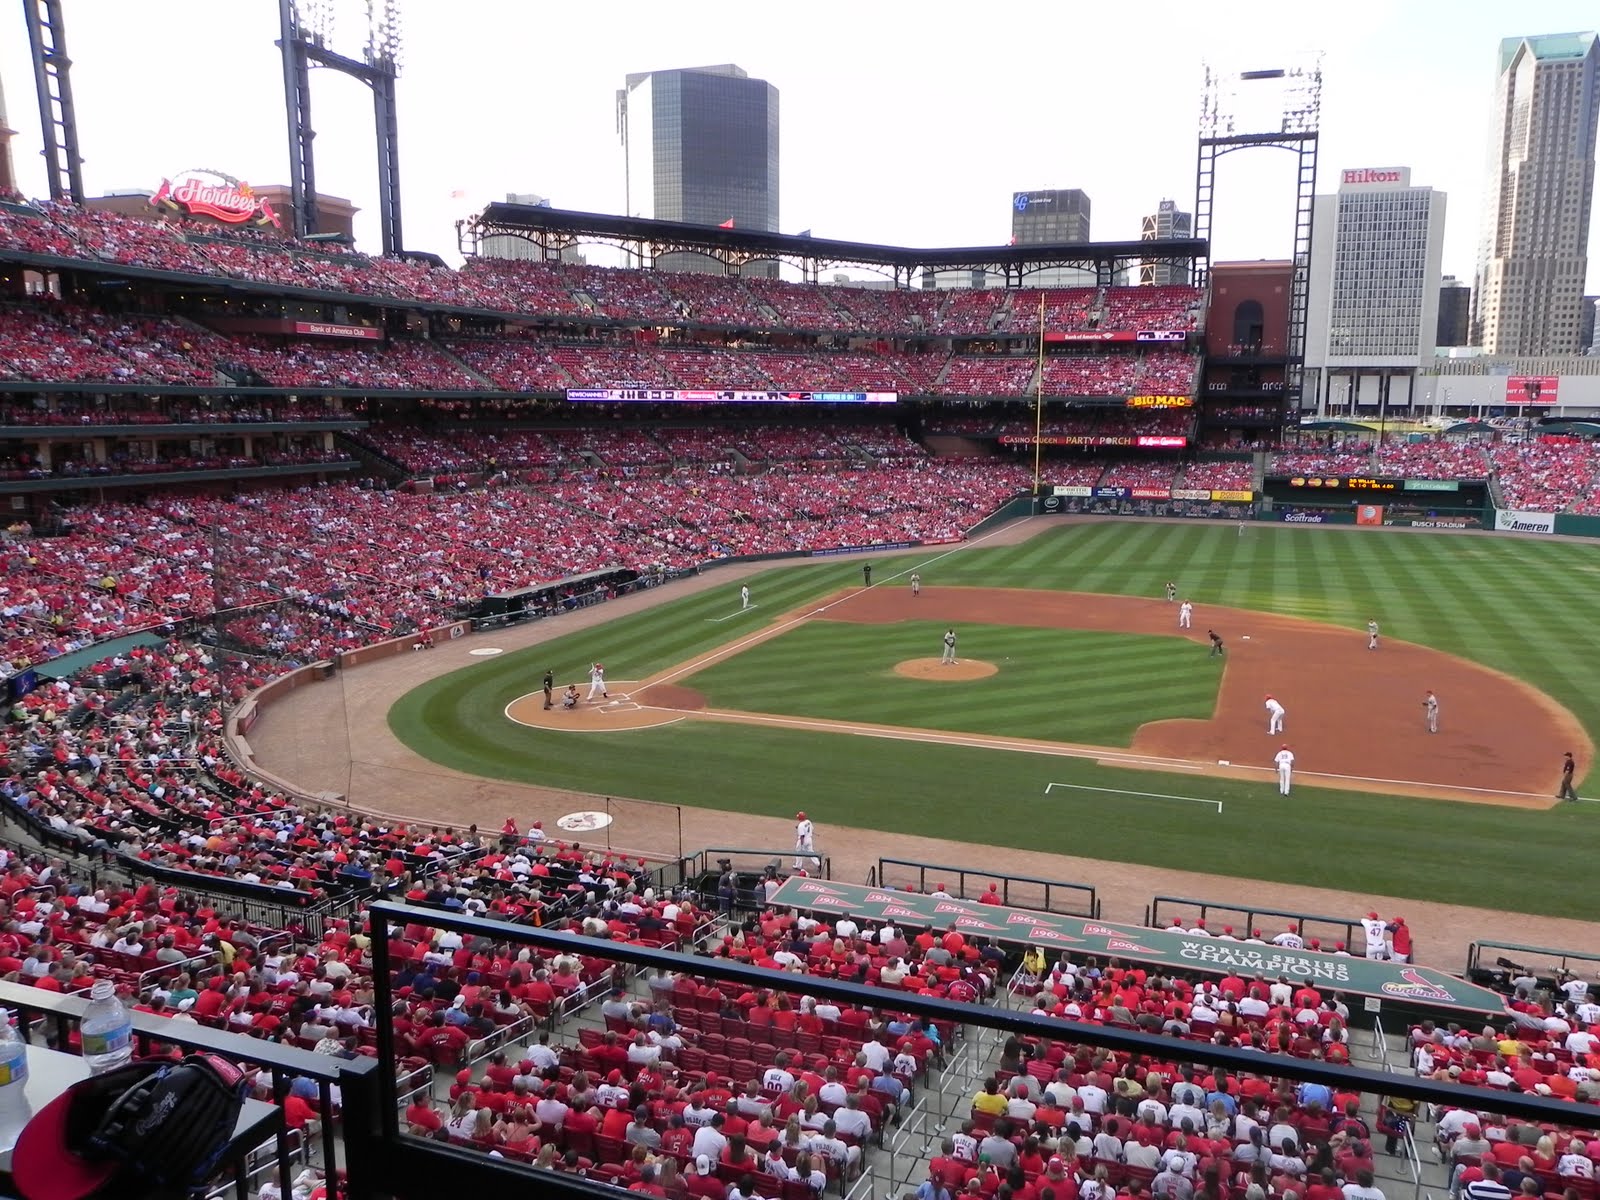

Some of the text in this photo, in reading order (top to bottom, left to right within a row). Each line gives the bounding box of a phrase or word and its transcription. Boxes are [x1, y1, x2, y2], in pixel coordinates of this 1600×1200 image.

[1344, 169, 1400, 184] Hilton
[310, 325, 325, 333] Bank
[332, 327, 353, 335] America
[1134, 396, 1186, 406] BIG MAC
[1003, 436, 1030, 444] CASINO
[1066, 437, 1095, 445] PARTY
[1099, 437, 1131, 445] PORCH
[1132, 489, 1170, 497] CARDINALS.COM
[1284, 512, 1322, 523] Scottrade
[1411, 520, 1466, 529] BUSCH STADIUM
[1510, 520, 1549, 532] Ameren
[803, 884, 826, 893] 1926
[870, 892, 892, 902] 1934
[940, 904, 965, 914] 1944
[960, 918, 985, 928] 1946
[1012, 915, 1037, 925] 1964
[1034, 929, 1059, 939] 1967
[1087, 926, 1112, 935] 1982
[1370, 927, 1381, 937] 47
[1111, 941, 1140, 951] 2006
[1181, 941, 1347, 971] WORLD SERIES
[1180, 949, 1350, 982] CHAMPIONS
[1381, 982, 1453, 1002] Cardinals
[900, 1064, 907, 1074] 4
[673, 1142, 681, 1153] 5
[815, 1142, 837, 1155] PUJOLS
[955, 1146, 965, 1158] 5
[1574, 1164, 1585, 1177] 5
